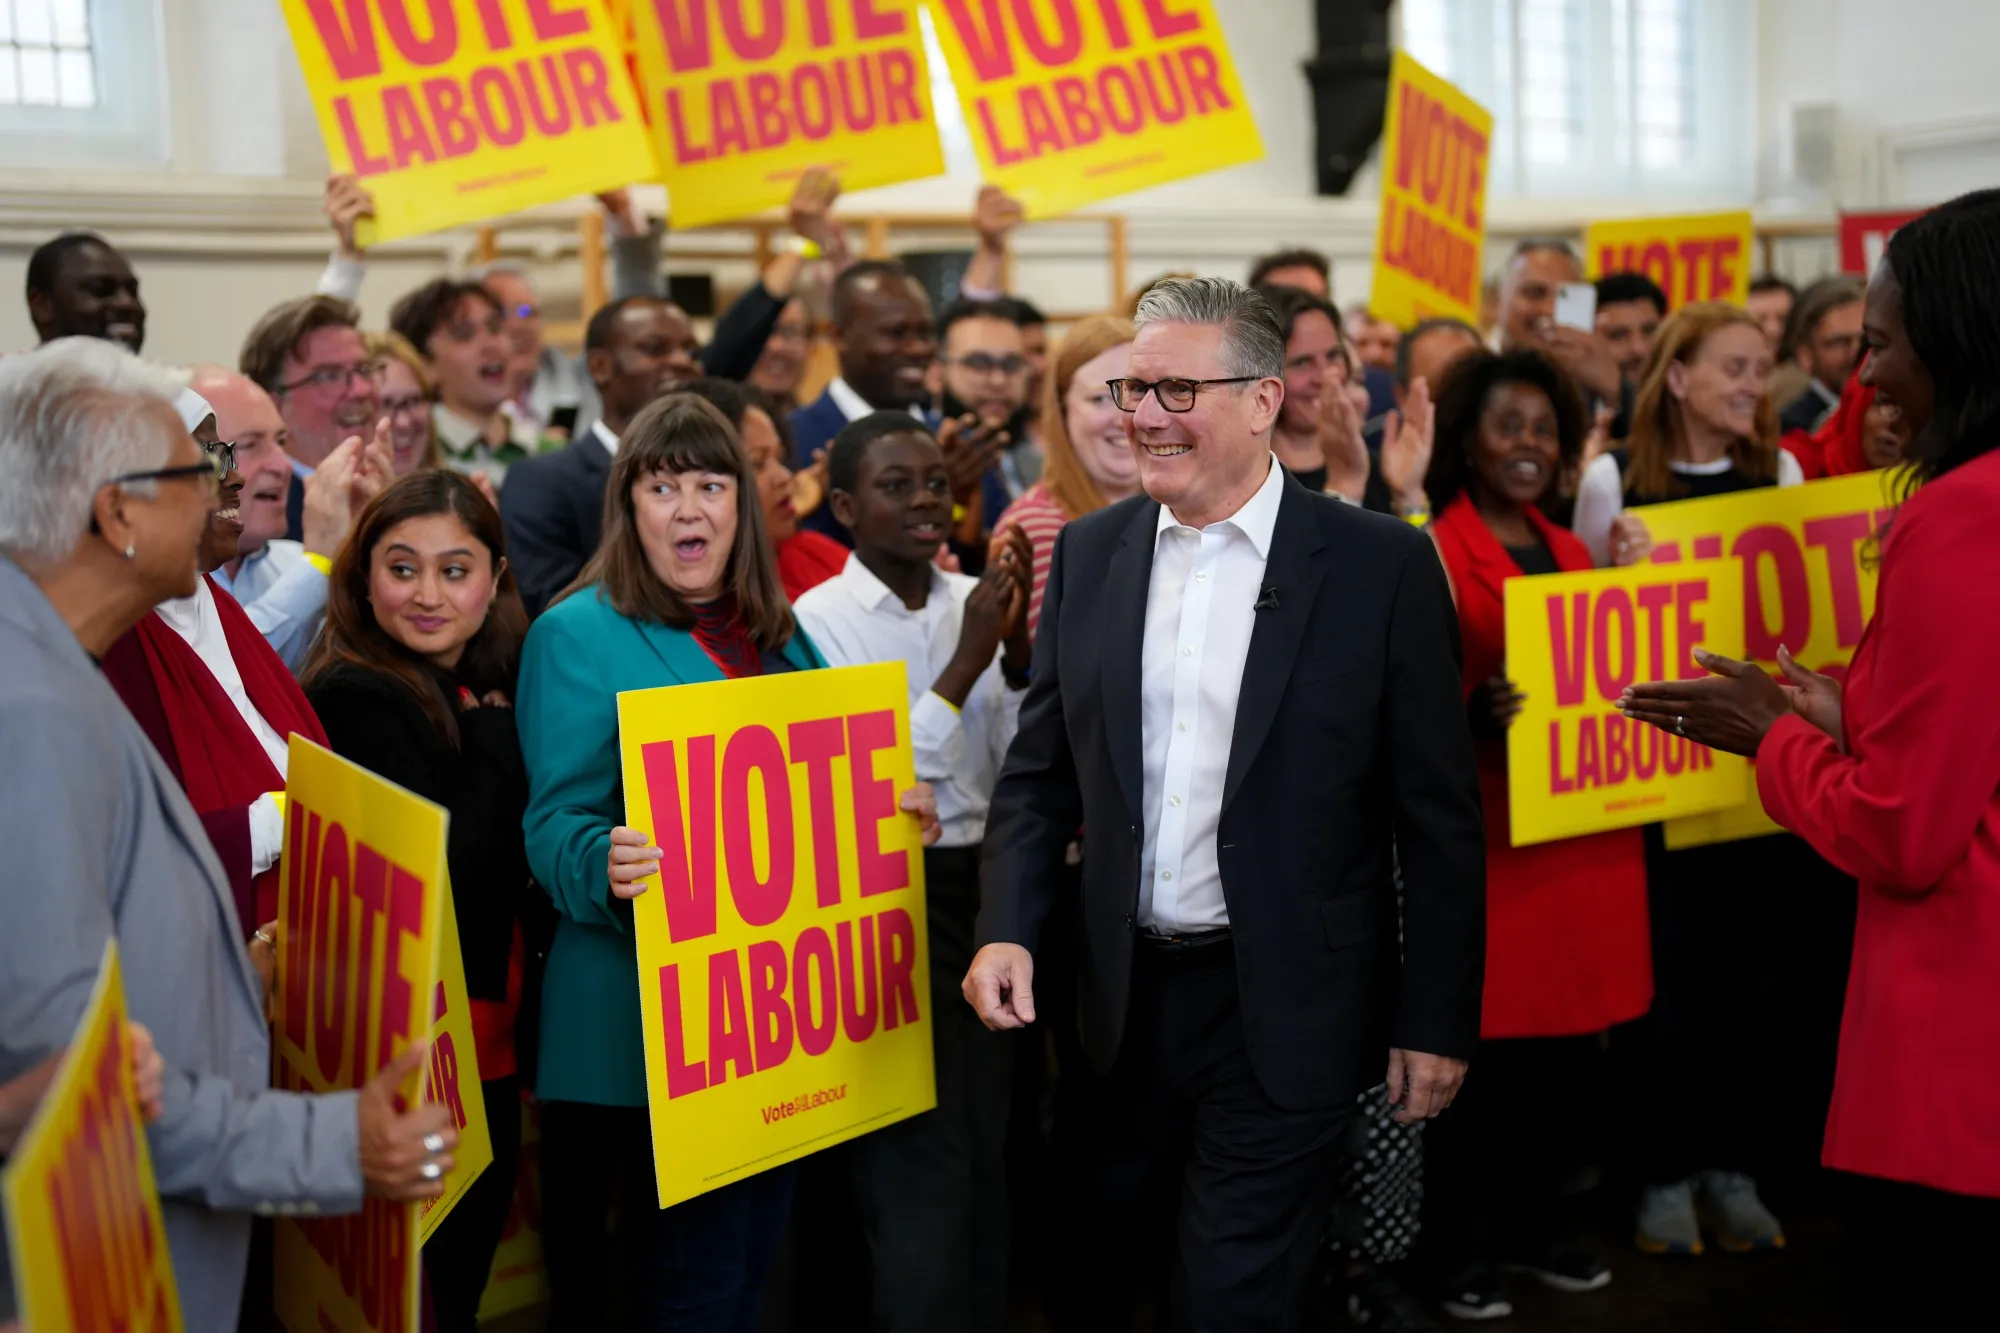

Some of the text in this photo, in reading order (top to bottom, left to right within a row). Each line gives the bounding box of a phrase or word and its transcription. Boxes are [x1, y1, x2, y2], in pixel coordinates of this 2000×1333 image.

[331, 47, 623, 179] LABOUR
[665, 47, 923, 165] LABOUR
[976, 44, 1233, 166] LABOUR
[1396, 79, 1487, 231] VOTE
[1546, 579, 1708, 706] VOTE
[1650, 504, 1900, 664] OT
[641, 709, 909, 944] VOTE
[285, 798, 424, 1107] VOTE
[659, 908, 919, 1100] LABOUR
[761, 1084, 847, 1125] Vote Labour
